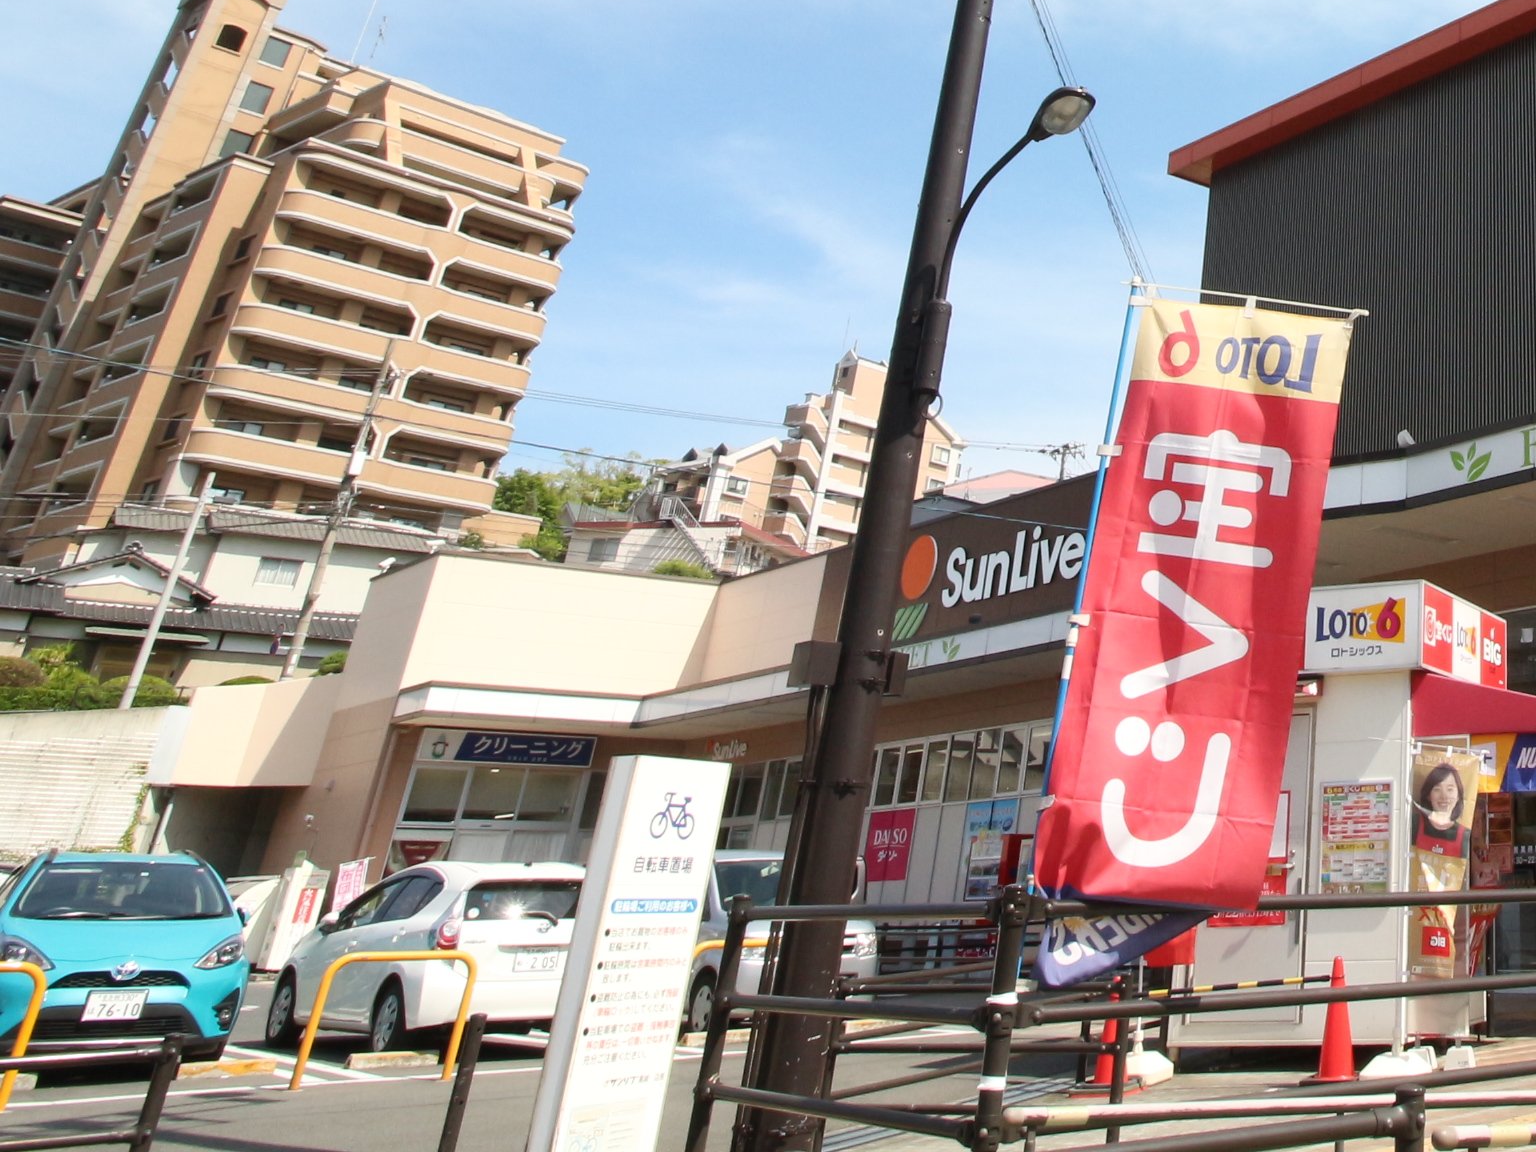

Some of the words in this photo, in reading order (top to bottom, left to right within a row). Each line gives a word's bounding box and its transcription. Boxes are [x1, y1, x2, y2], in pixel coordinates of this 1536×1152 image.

[941, 525, 1086, 608] SunLive
[1315, 606, 1368, 642] LOTO
[1376, 596, 1401, 639] 6
[1331, 645, 1383, 658] ロトシックス
[1483, 627, 1502, 666] BIG
[473, 736, 586, 758] クリーニング
[713, 739, 748, 759] SunLive
[633, 856, 694, 874] 自転車置場
[97, 1002, 141, 1017] 76-10
